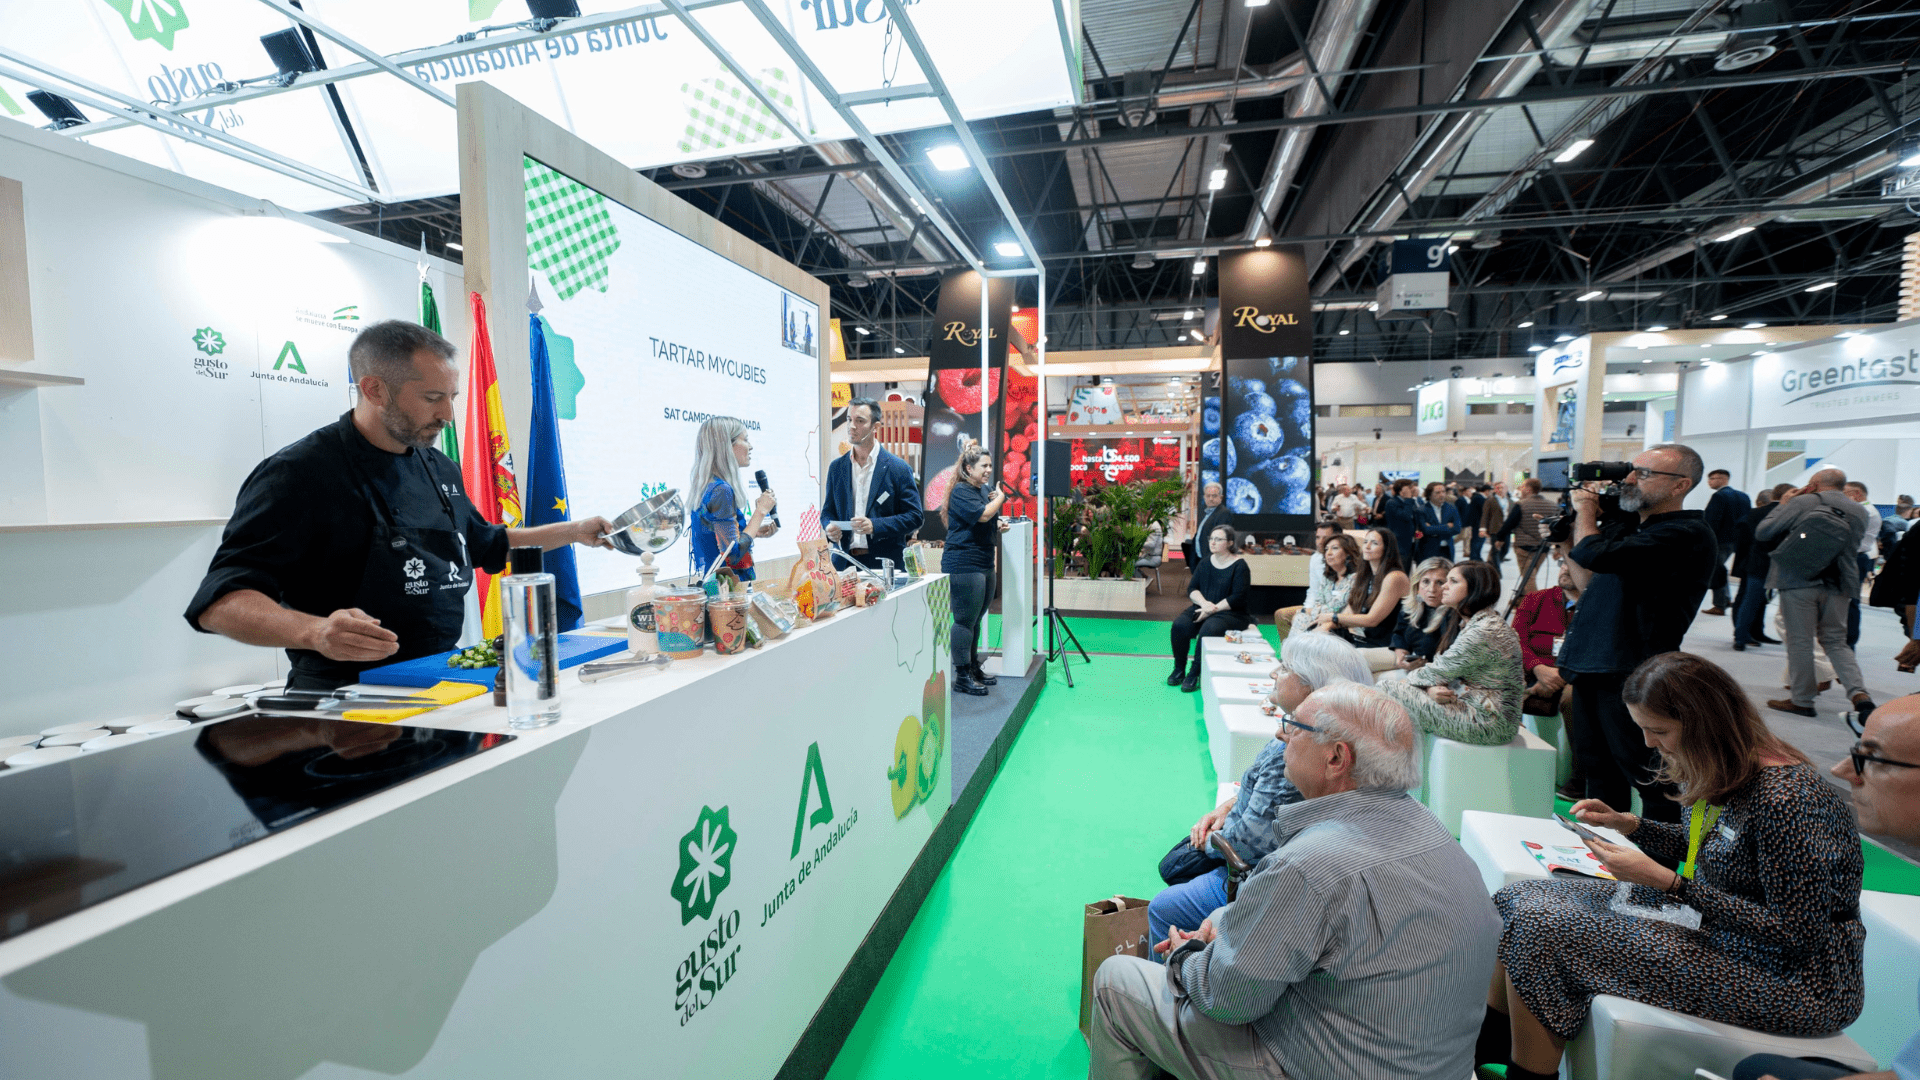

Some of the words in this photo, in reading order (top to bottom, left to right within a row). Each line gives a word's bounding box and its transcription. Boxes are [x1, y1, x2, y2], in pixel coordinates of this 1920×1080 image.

[1426, 245, 1445, 268] 9
[338, 323, 358, 334] Europa
[943, 320, 997, 346] ROYL
[194, 357, 228, 370] gusto
[649, 336, 705, 370] TARTAR
[708, 353, 767, 385] MYCUBIES
[205, 367, 229, 380] Sur
[250, 370, 275, 381] Junta
[277, 374, 288, 383] de
[289, 375, 329, 388] Andalucía
[664, 407, 681, 421] SAT
[682, 409, 716, 424] CAMPO
[1082, 455, 1103, 463] hasta
[404, 578, 429, 591] gusto
[412, 586, 430, 595] Sur
[760, 874, 796, 928] Junta
[797, 859, 812, 885] de
[812, 806, 858, 869] Andalucía
[674, 908, 741, 1011] gusto
[679, 993, 699, 1027] del
[699, 944, 742, 1010] Sur
